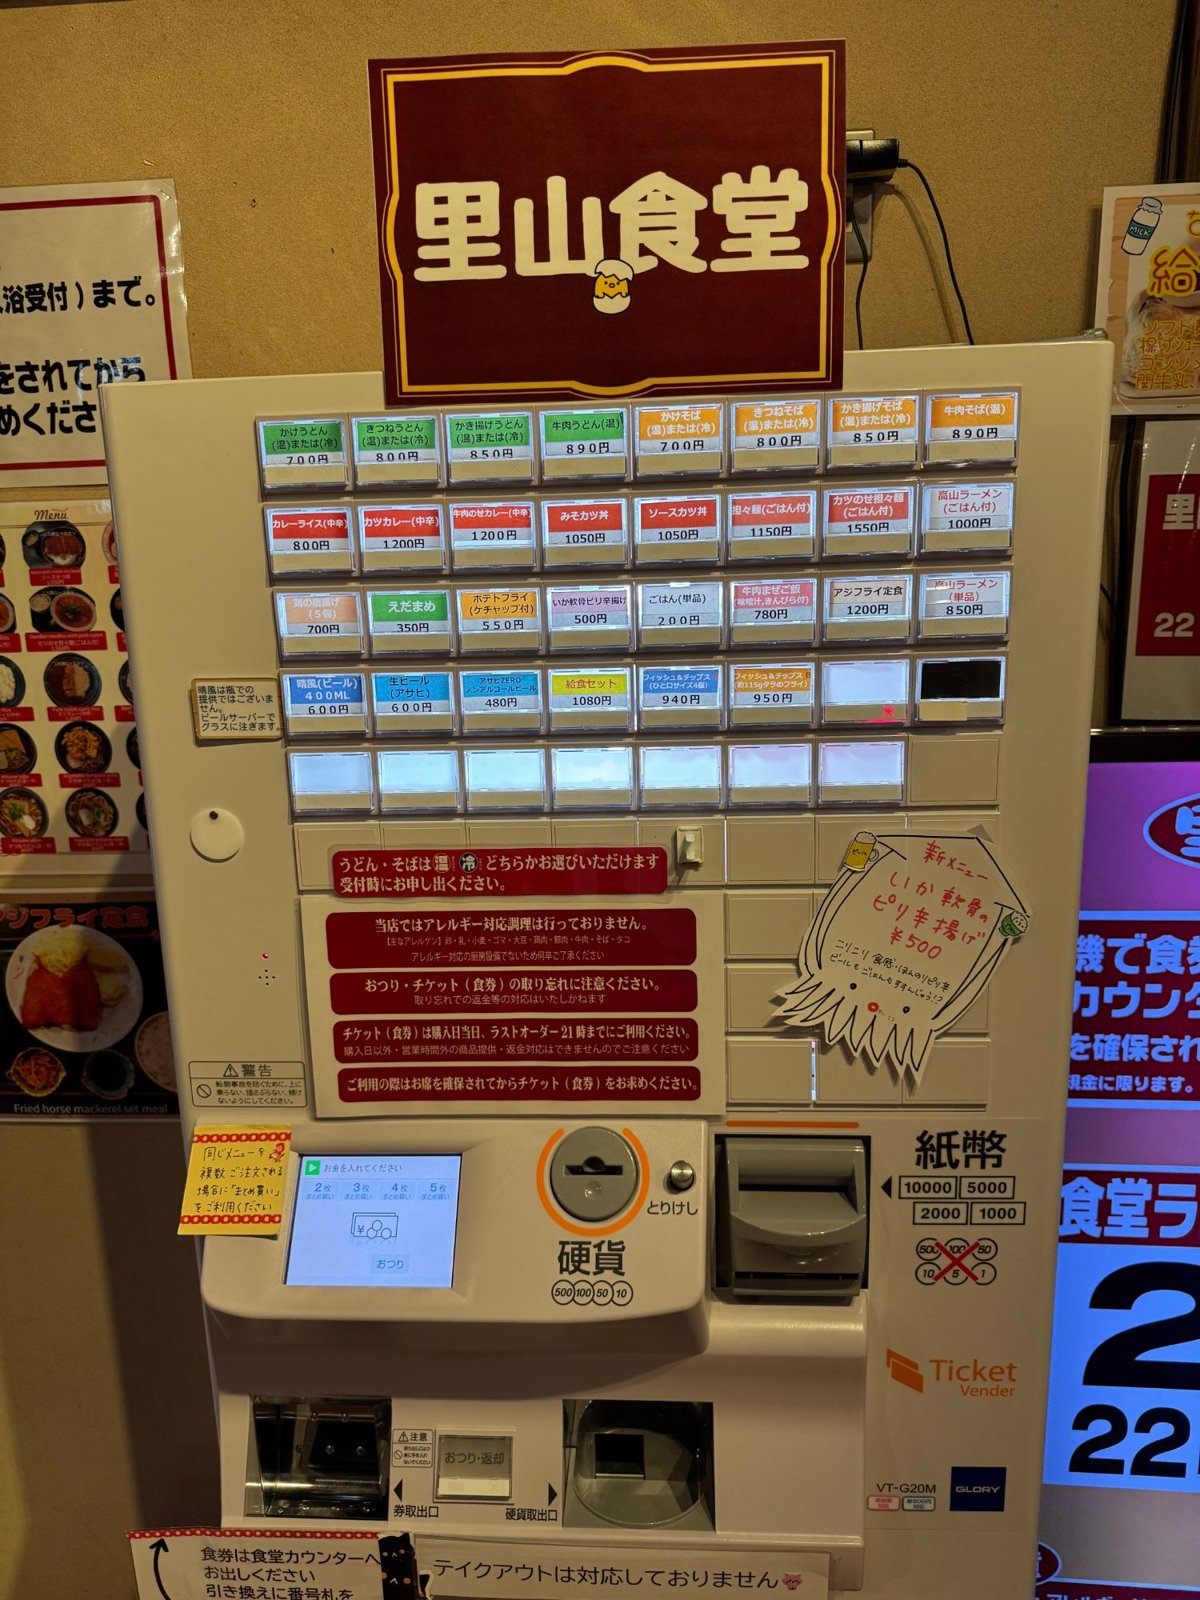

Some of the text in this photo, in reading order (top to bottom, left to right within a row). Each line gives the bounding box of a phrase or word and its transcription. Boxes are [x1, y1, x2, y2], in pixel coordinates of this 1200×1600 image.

[414, 165, 809, 282] 里山食堂
[0, 276, 155, 314] 浴受付）まで。
[660, 410, 701, 422] かけそば
[753, 405, 804, 417] きつねそば
[366, 422, 423, 434] きつねうどん
[455, 419, 524, 431] かき揚げうどん
[280, 426, 328, 437] かけうどん
[853, 430, 899, 442] 850円
[952, 427, 998, 439] 890円
[660, 439, 704, 451] 700円
[757, 434, 802, 447] 800円
[566, 441, 609, 454] 890円
[286, 454, 328, 465] 700円
[376, 451, 418, 462] 800円
[938, 488, 1003, 501] 高山ラーメン
[34, 510, 68, 520] Menu
[560, 509, 609, 522] みそカツ丼
[648, 505, 707, 519] ソースカツ丼
[1163, 493, 1200, 530] 里
[847, 521, 889, 533] 1550円
[948, 517, 991, 529] 1000円
[471, 529, 517, 541] 1200円
[657, 529, 699, 541] 1050円
[750, 526, 792, 537] 1150円
[383, 537, 425, 549] 1200円
[565, 532, 606, 544] 1050円
[293, 540, 330, 551] 800円
[833, 585, 904, 597] アジフライ定食
[388, 600, 436, 613] えだまめ
[847, 604, 889, 615] 1200円
[946, 604, 983, 615] 850円
[574, 613, 607, 624] 500円
[754, 608, 788, 619] 780円
[482, 619, 524, 631] 550円
[658, 615, 700, 626] 200円
[1153, 612, 1195, 637] 22
[307, 624, 340, 634] 700円
[397, 622, 429, 633] 350円
[389, 676, 429, 686] 生ビール
[566, 678, 617, 689] 給食セット
[485, 697, 517, 708] 480円
[572, 695, 612, 706] 1080円
[662, 694, 700, 704] 940円
[753, 692, 792, 703] 950円
[308, 704, 349, 715] 600円
[391, 702, 432, 712] 600円
[201, 713, 276, 722] ビールサーバーで
[924, 840, 988, 880] 新メニュー
[339, 876, 505, 894] 受付時にお申し出ください。
[890, 871, 988, 923] いか軟骨の
[0, 905, 148, 929] ジフライ定食
[873, 894, 985, 945] ピリ辛揚げ
[375, 916, 647, 933] 当店ではアレルギー対応調理は行っておりません。
[241, 1063, 272, 1077] 警告
[14, 1103, 168, 1114] Fried horse mackerel set meal
[204, 1146, 266, 1161] 同じメニューを
[915, 1130, 1007, 1170] 紙幣
[324, 1163, 403, 1173] お金を入れてください
[904, 1182, 1007, 1194] 10000 5000
[646, 1200, 698, 1216] とりけし
[920, 1208, 1017, 1219] 2000 1000
[376, 1258, 404, 1270] おつり
[557, 1240, 626, 1277] 硬貨
[554, 1287, 627, 1298] 500 100 50 10
[929, 1359, 1018, 1382] Ticket
[960, 1384, 1016, 1397] Vender
[444, 1452, 504, 1465] おつり・返却
[876, 1483, 937, 1493] VT-G20M
[393, 1505, 439, 1518] 券取出口
[506, 1507, 558, 1522] 硬貨取出口
[201, 1546, 382, 1566] 食券は食堂カウンターへ
[204, 1566, 316, 1583] お出しください
[433, 1559, 779, 1590] テイクアウトは対応しておりません
